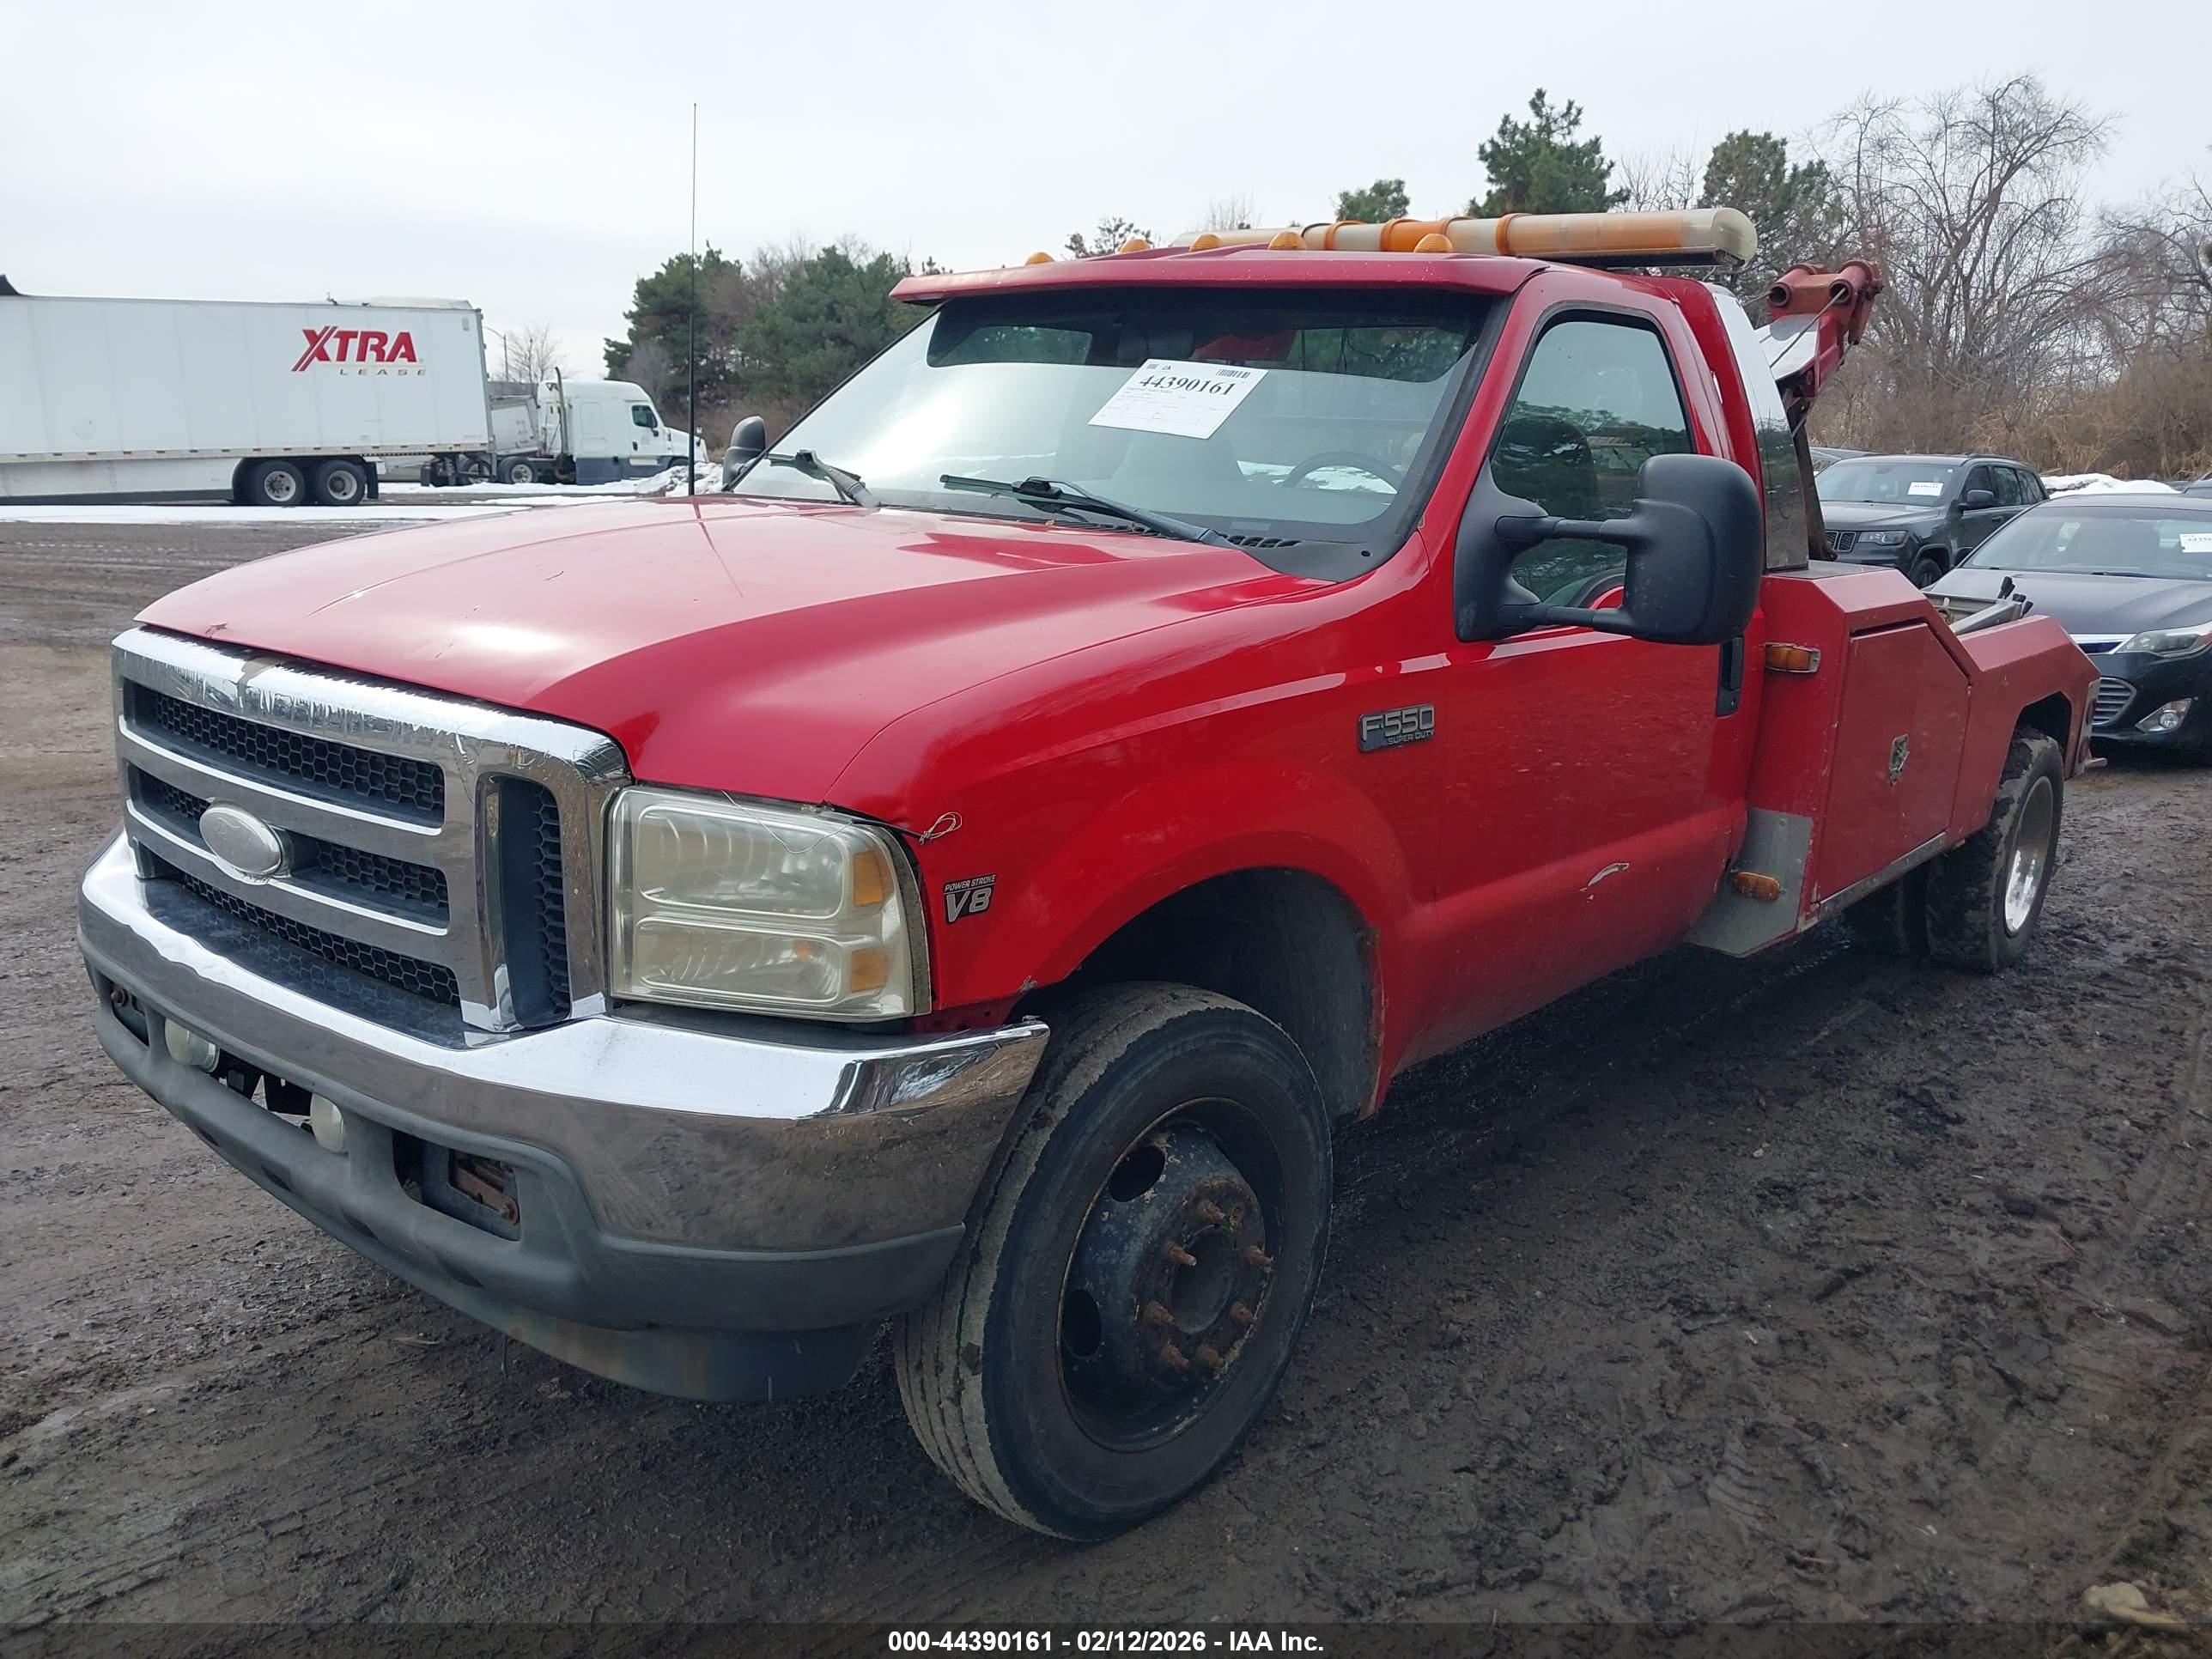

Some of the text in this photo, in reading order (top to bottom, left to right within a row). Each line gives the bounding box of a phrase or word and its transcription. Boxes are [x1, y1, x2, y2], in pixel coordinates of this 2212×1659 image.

[291, 325, 417, 372] XTRA
[1139, 374, 1237, 396] 44390161
[1387, 729, 1435, 744] SUPER DUTY
[944, 874, 996, 892] POWER STROKE
[945, 887, 992, 923] V8
